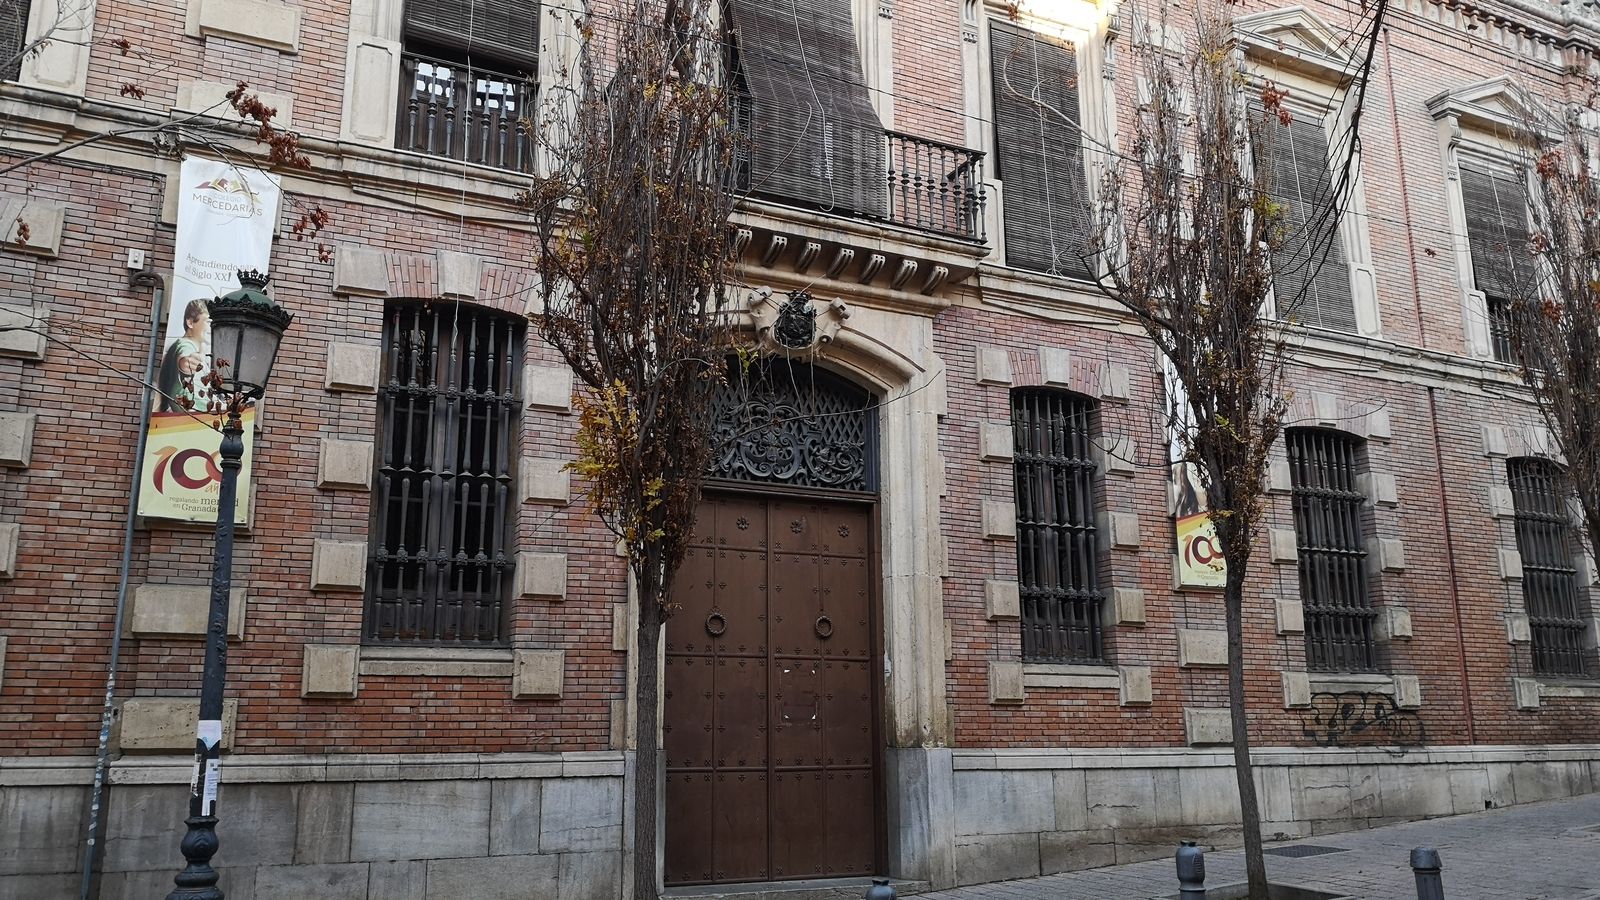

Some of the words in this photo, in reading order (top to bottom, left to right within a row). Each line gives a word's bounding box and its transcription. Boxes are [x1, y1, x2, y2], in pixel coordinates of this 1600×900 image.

[192, 193, 263, 217] MERCEDARIAS
[186, 253, 238, 272] Aprendiendo
[191, 267, 212, 281] Siglo
[169, 496, 199, 504] regalando
[181, 503, 217, 513] Granada
